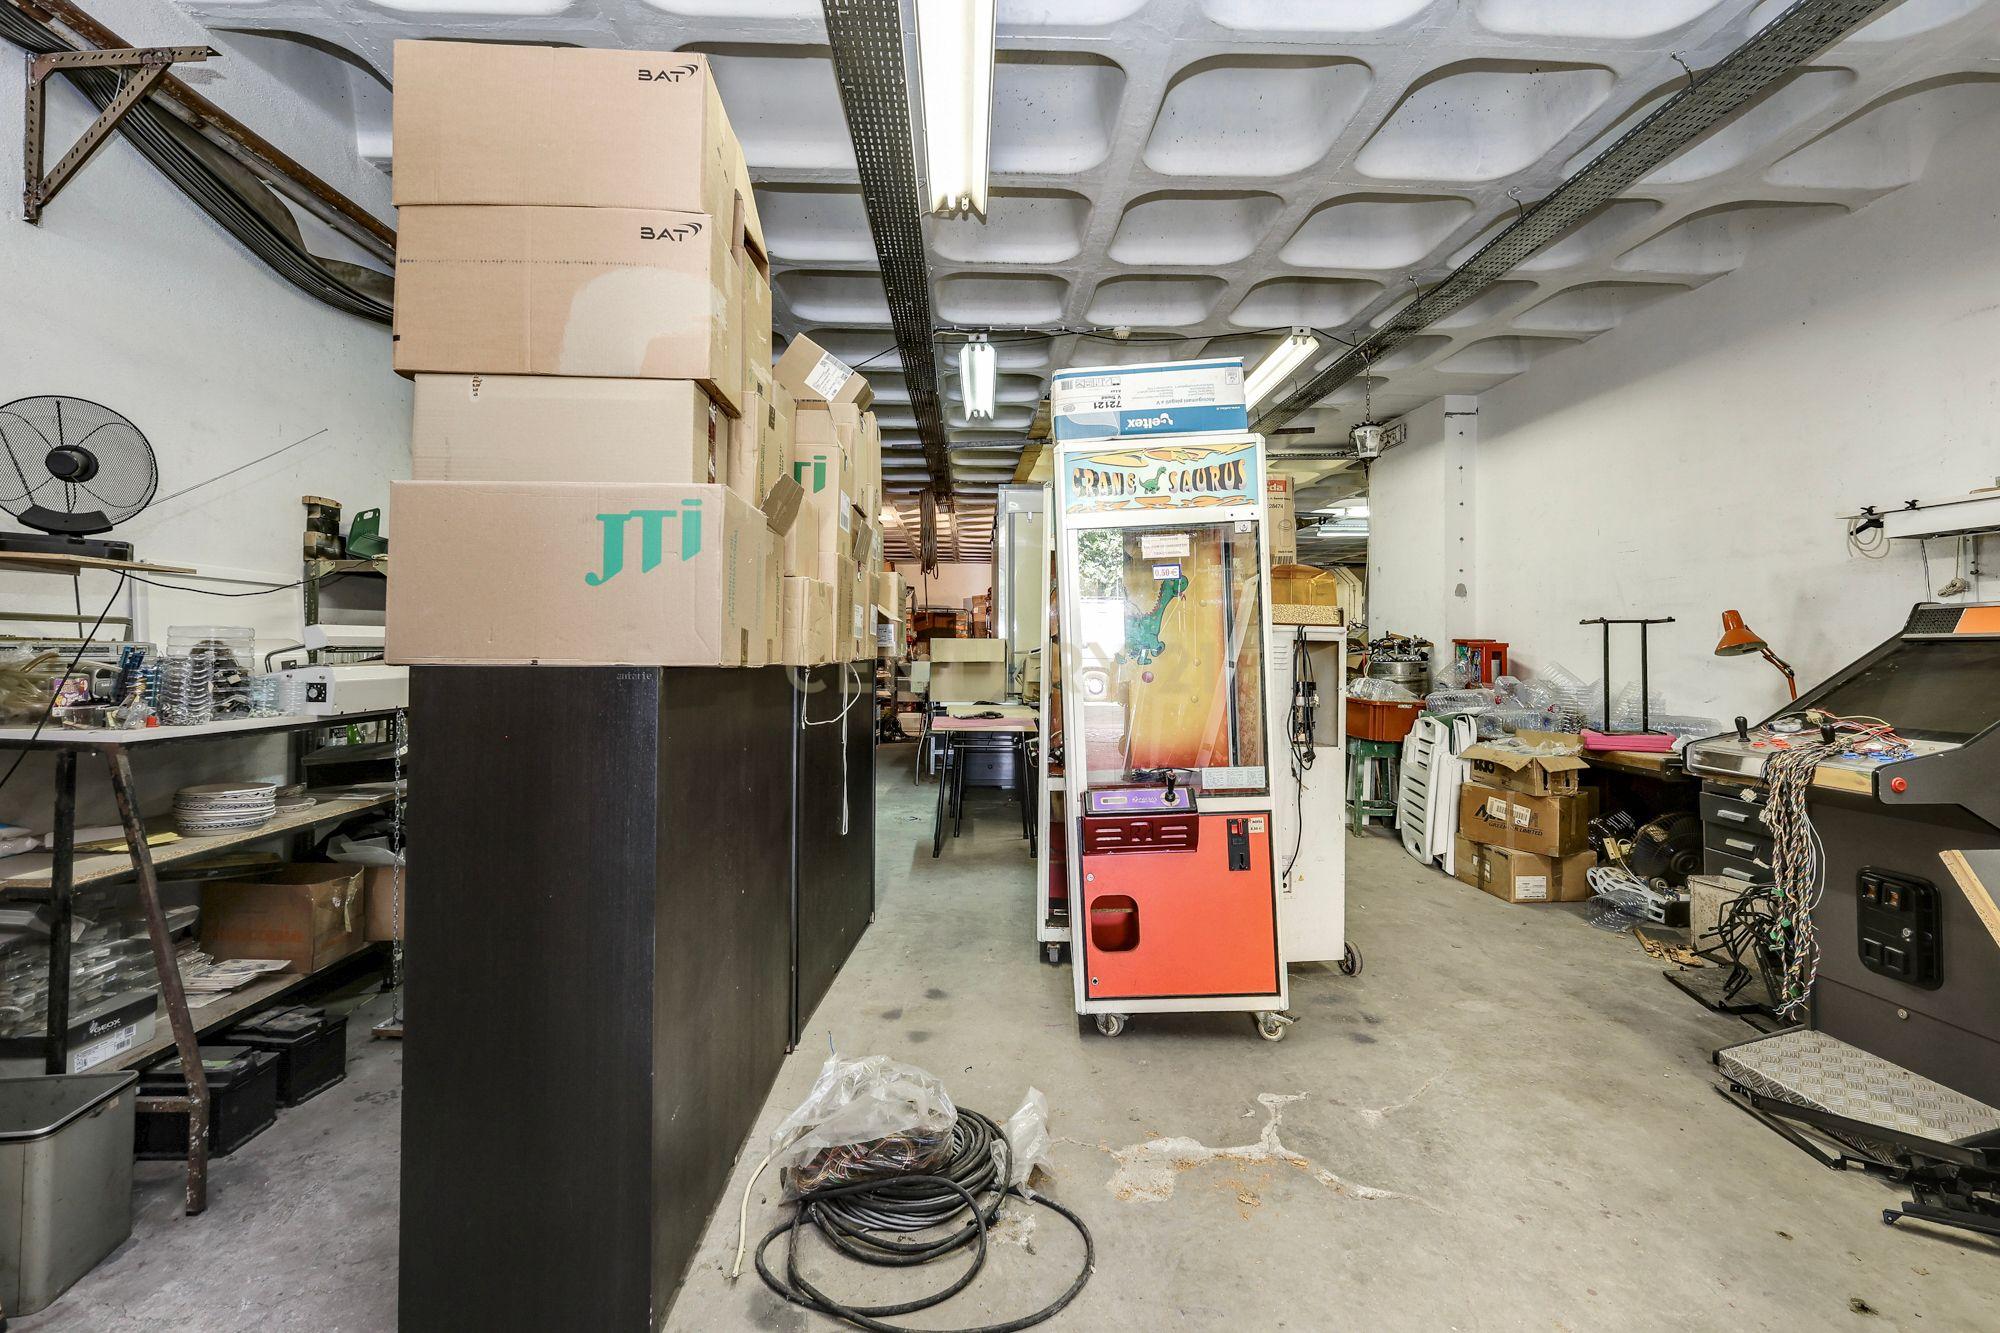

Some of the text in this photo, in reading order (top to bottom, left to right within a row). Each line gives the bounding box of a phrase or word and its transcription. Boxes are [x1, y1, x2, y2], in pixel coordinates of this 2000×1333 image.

[638, 68, 688, 82] BAT
[640, 226, 691, 242] BAT
[1093, 401, 1122, 410] 72121
[794, 455, 827, 494] Ti
[1073, 459, 1248, 498] CRANE SAURUS
[94, 1018, 121, 1033] GEOX
